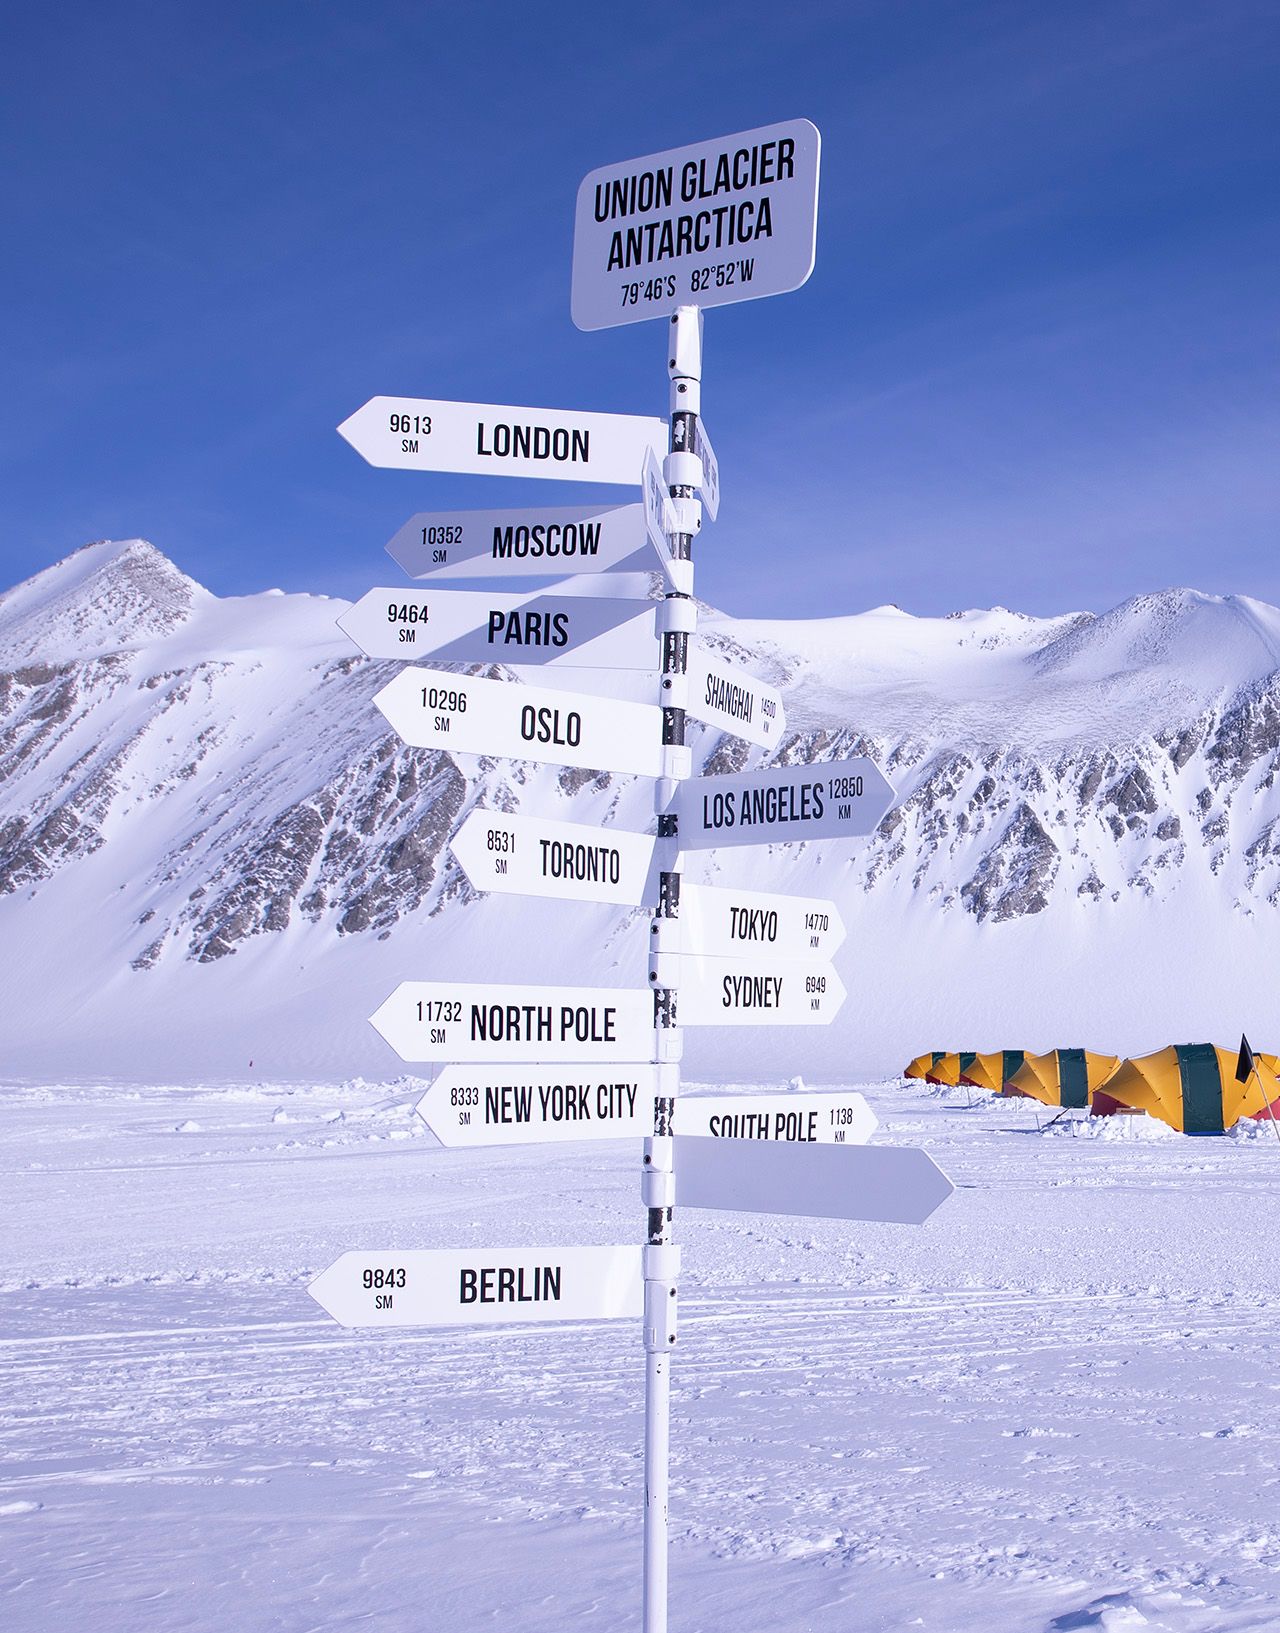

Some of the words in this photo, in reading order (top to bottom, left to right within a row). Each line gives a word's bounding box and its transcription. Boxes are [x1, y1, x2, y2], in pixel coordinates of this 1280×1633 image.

[594, 167, 672, 222] UNION
[680, 138, 795, 203] GLACIER
[607, 198, 772, 272] ANTARCTICA
[389, 413, 432, 435] 9613
[401, 439, 419, 453] SM
[477, 422, 590, 463] LONDON
[421, 525, 463, 545] 10352
[492, 522, 602, 559] MOSCOW
[432, 549, 447, 563] SM
[387, 603, 429, 624] 9464
[398, 628, 416, 643] SM
[487, 610, 569, 647] PARIS
[421, 687, 467, 713] 10296
[705, 673, 754, 723] SHANGHAI
[434, 716, 450, 732] SM
[520, 704, 581, 747] OSLO
[828, 775, 863, 800] 12850
[703, 791, 735, 830] LOS
[739, 782, 824, 826] ANGELES
[838, 804, 851, 820] KM
[487, 829, 515, 854] 8531
[495, 858, 507, 874] SM
[539, 839, 620, 885] TORONTO
[730, 906, 778, 943] TOKYO
[805, 913, 829, 932] 14770
[810, 936, 820, 947] KM
[722, 975, 783, 1008] SYDNEY
[805, 976, 826, 994] 6949
[416, 1000, 462, 1022] 11732
[811, 998, 820, 1009] KM
[470, 1004, 552, 1042] NORTH
[560, 1006, 617, 1042] POLE
[430, 1028, 446, 1044] SM
[450, 1086, 479, 1107] 8333
[485, 1085, 533, 1124] NEW
[537, 1084, 591, 1122] YORK
[596, 1083, 638, 1120] CITY
[458, 1111, 471, 1126] SM
[709, 1113, 770, 1140] SOUTH
[775, 1112, 818, 1142] POLE
[830, 1107, 853, 1125] 1138
[834, 1130, 846, 1143] KM
[362, 1268, 406, 1289] 9843
[459, 1266, 561, 1304] BERLIN
[375, 1294, 393, 1310] SM
